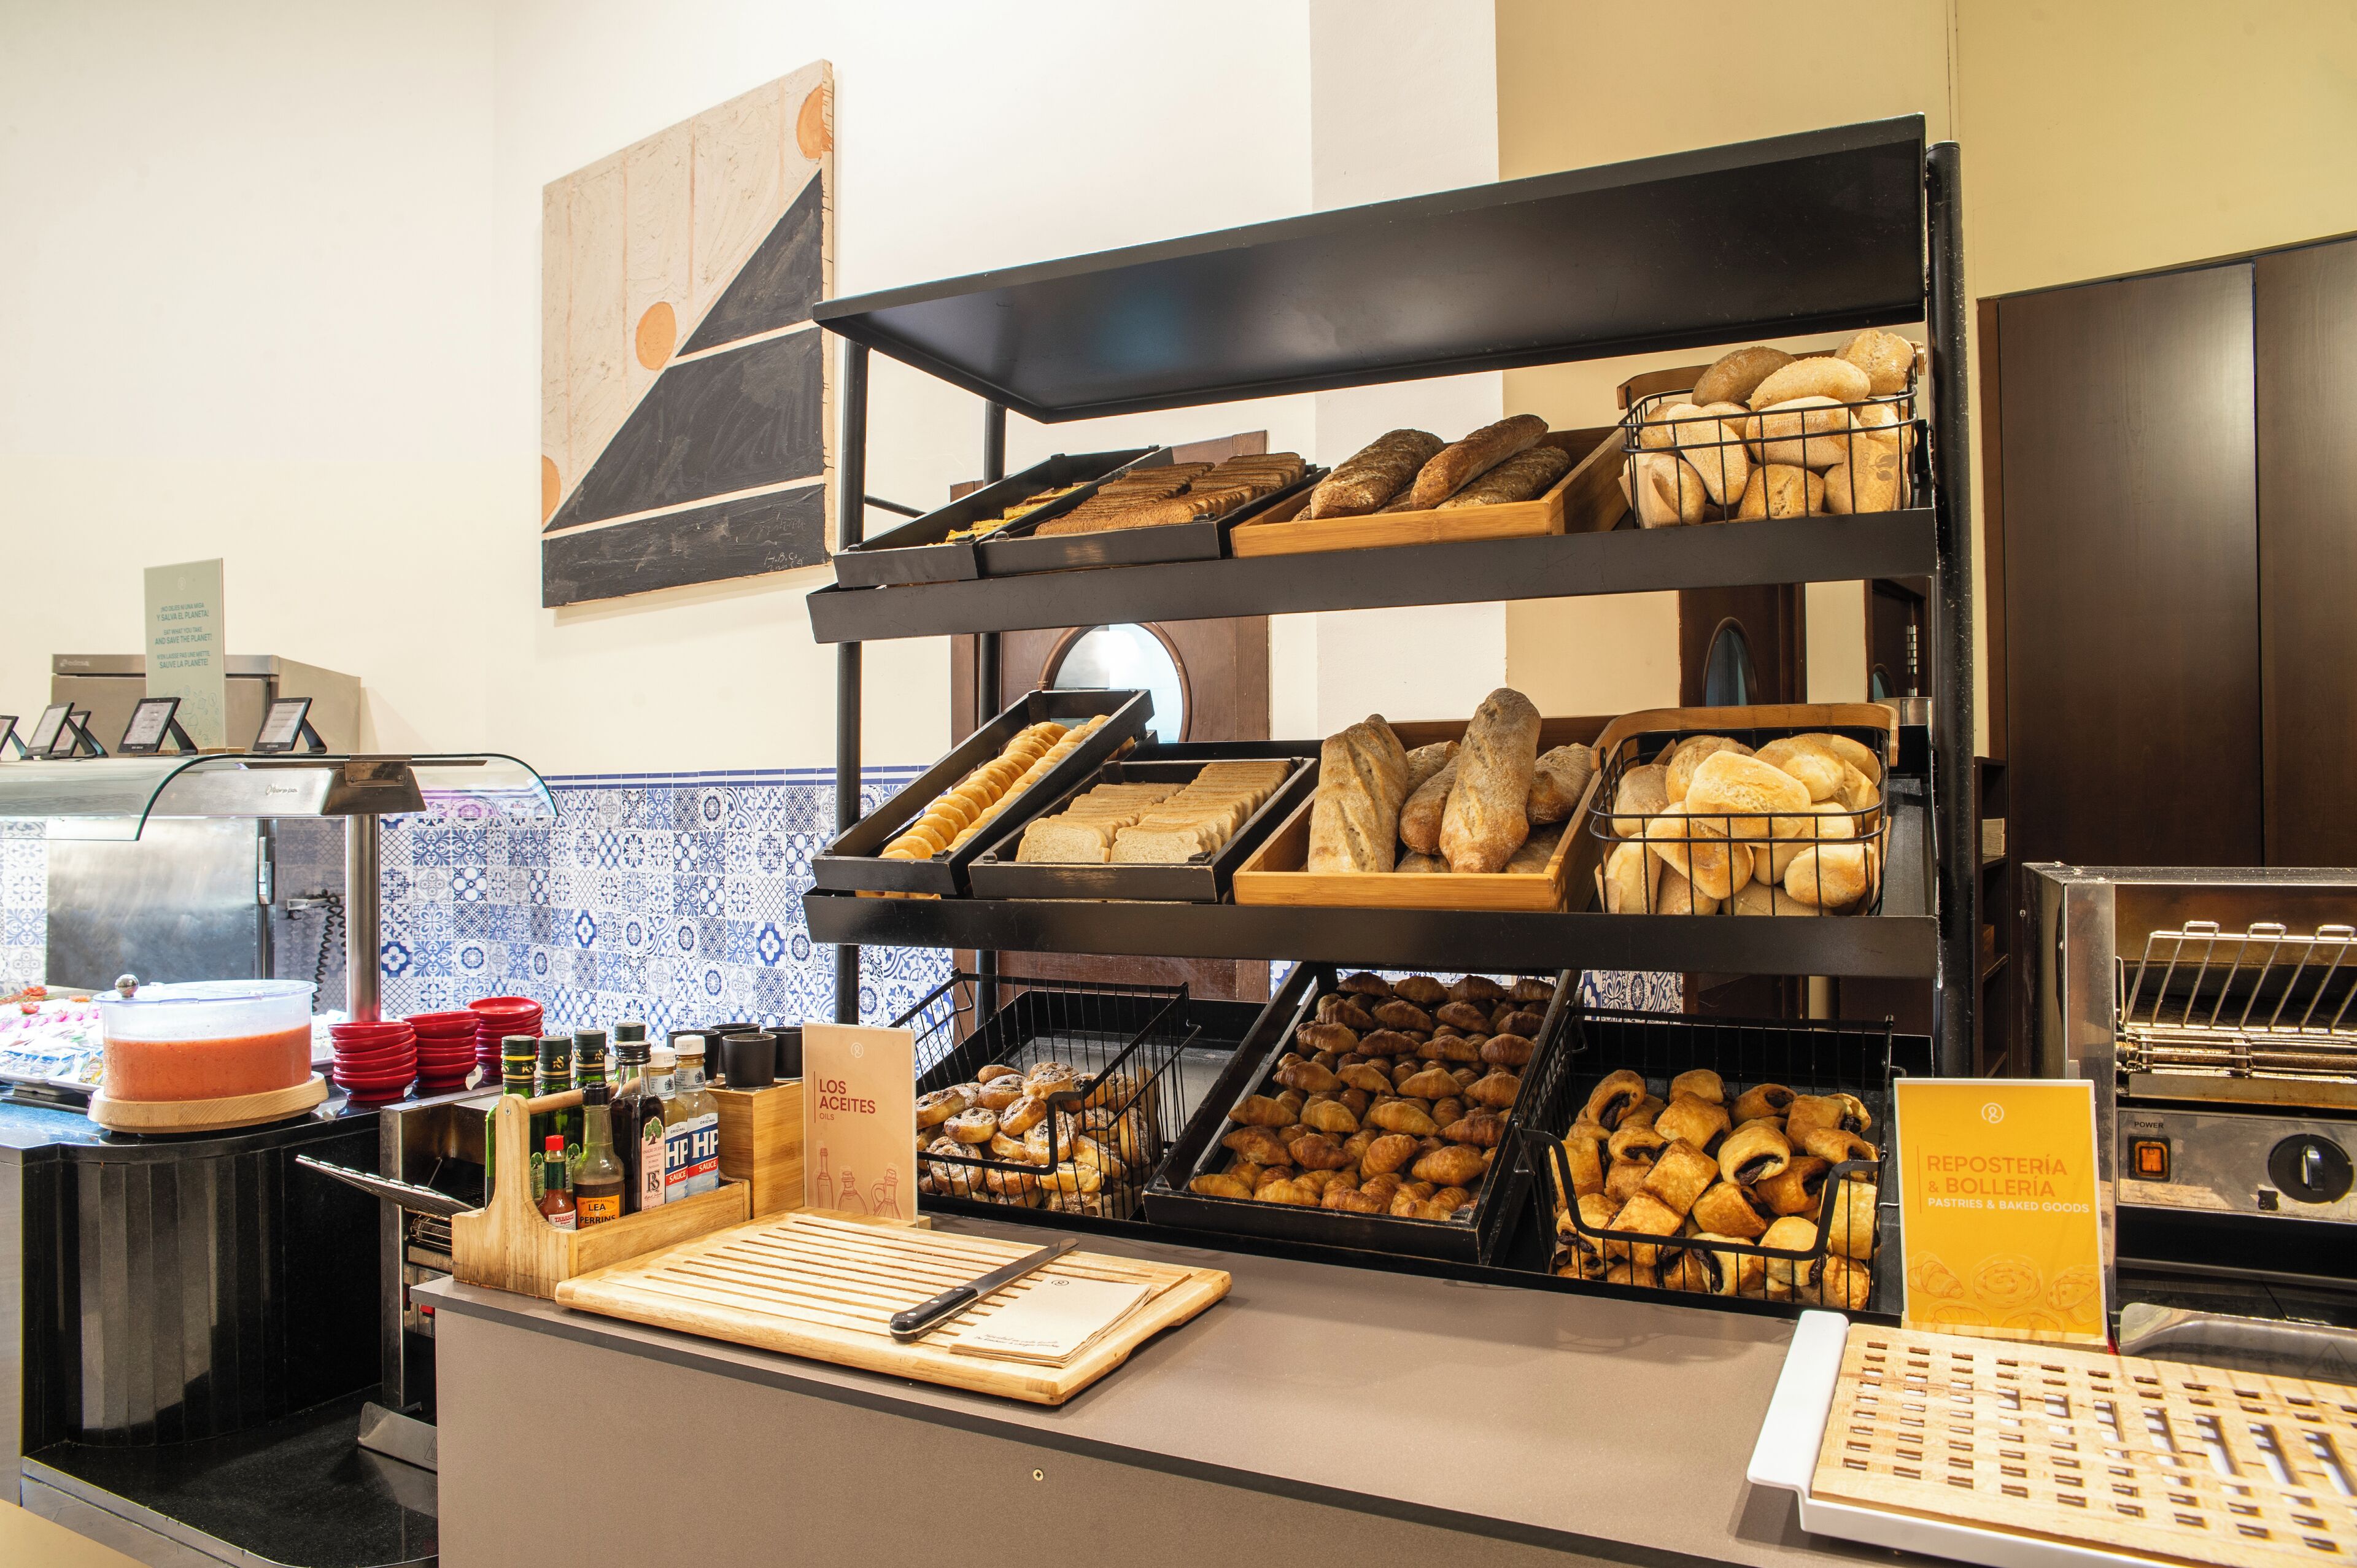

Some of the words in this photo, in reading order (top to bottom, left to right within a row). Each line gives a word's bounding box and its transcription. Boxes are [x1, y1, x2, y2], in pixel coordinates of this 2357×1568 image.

[1856, 452, 1870, 474] ECO
[185, 609, 209, 619] PLANETA!
[819, 1078, 846, 1095] LOS
[819, 1095, 876, 1114] ACEITES
[665, 1138, 687, 1168] HP
[692, 1129, 718, 1159] HP
[699, 1160, 717, 1173] SAUCE
[1927, 1154, 2068, 1176] REPOSTERÍA
[669, 1170, 686, 1183] SAUCE
[1929, 1180, 1940, 1193] &
[1946, 1176, 2056, 1197] BOLLERÍA
[1928, 1198, 1983, 1208] PASTRIES
[1987, 1200, 1995, 1209] &
[1999, 1200, 2038, 1211] BAKED
[2042, 1202, 2090, 1213] GOODS
[579, 1215, 616, 1224] PERRINS
